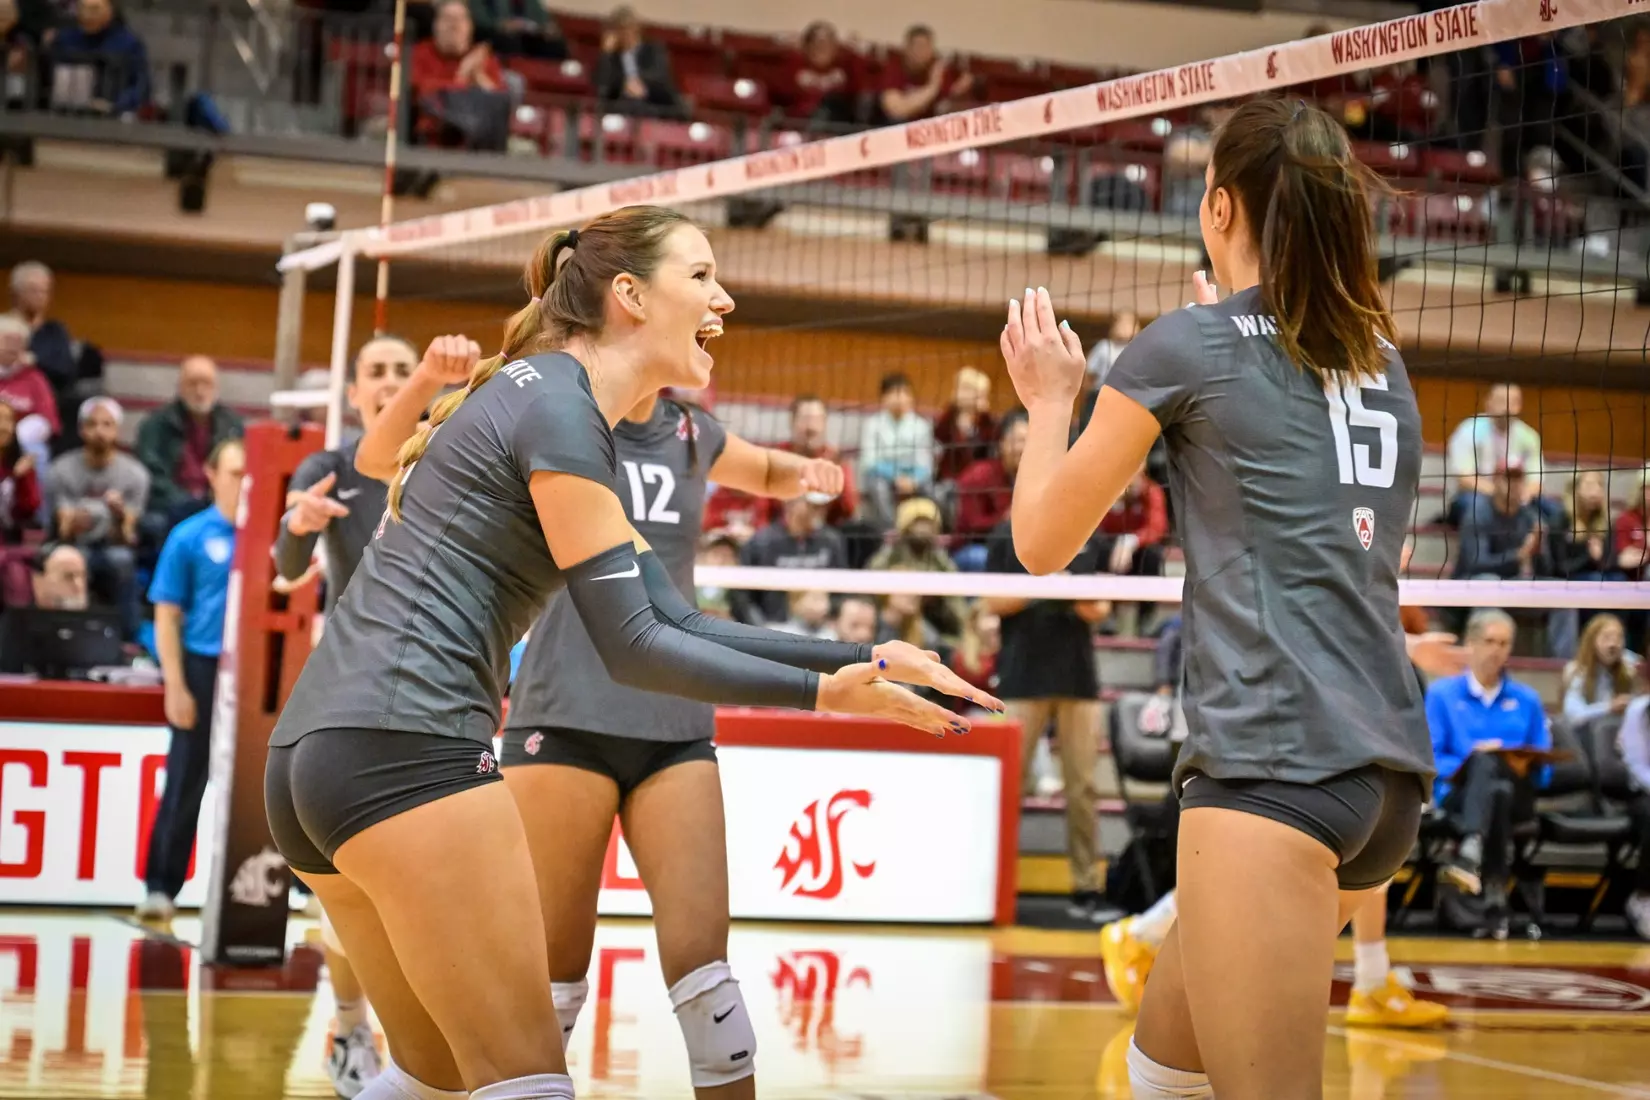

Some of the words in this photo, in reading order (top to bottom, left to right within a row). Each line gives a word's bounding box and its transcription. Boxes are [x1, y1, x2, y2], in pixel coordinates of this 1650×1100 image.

[1331, 14, 1428, 65] WASHINGTON
[1433, 4, 1479, 44] STATE
[1096, 71, 1176, 112] WASHINGTON
[1179, 62, 1216, 96] STATE
[1321, 367, 1399, 489] 15
[622, 460, 680, 525] 12
